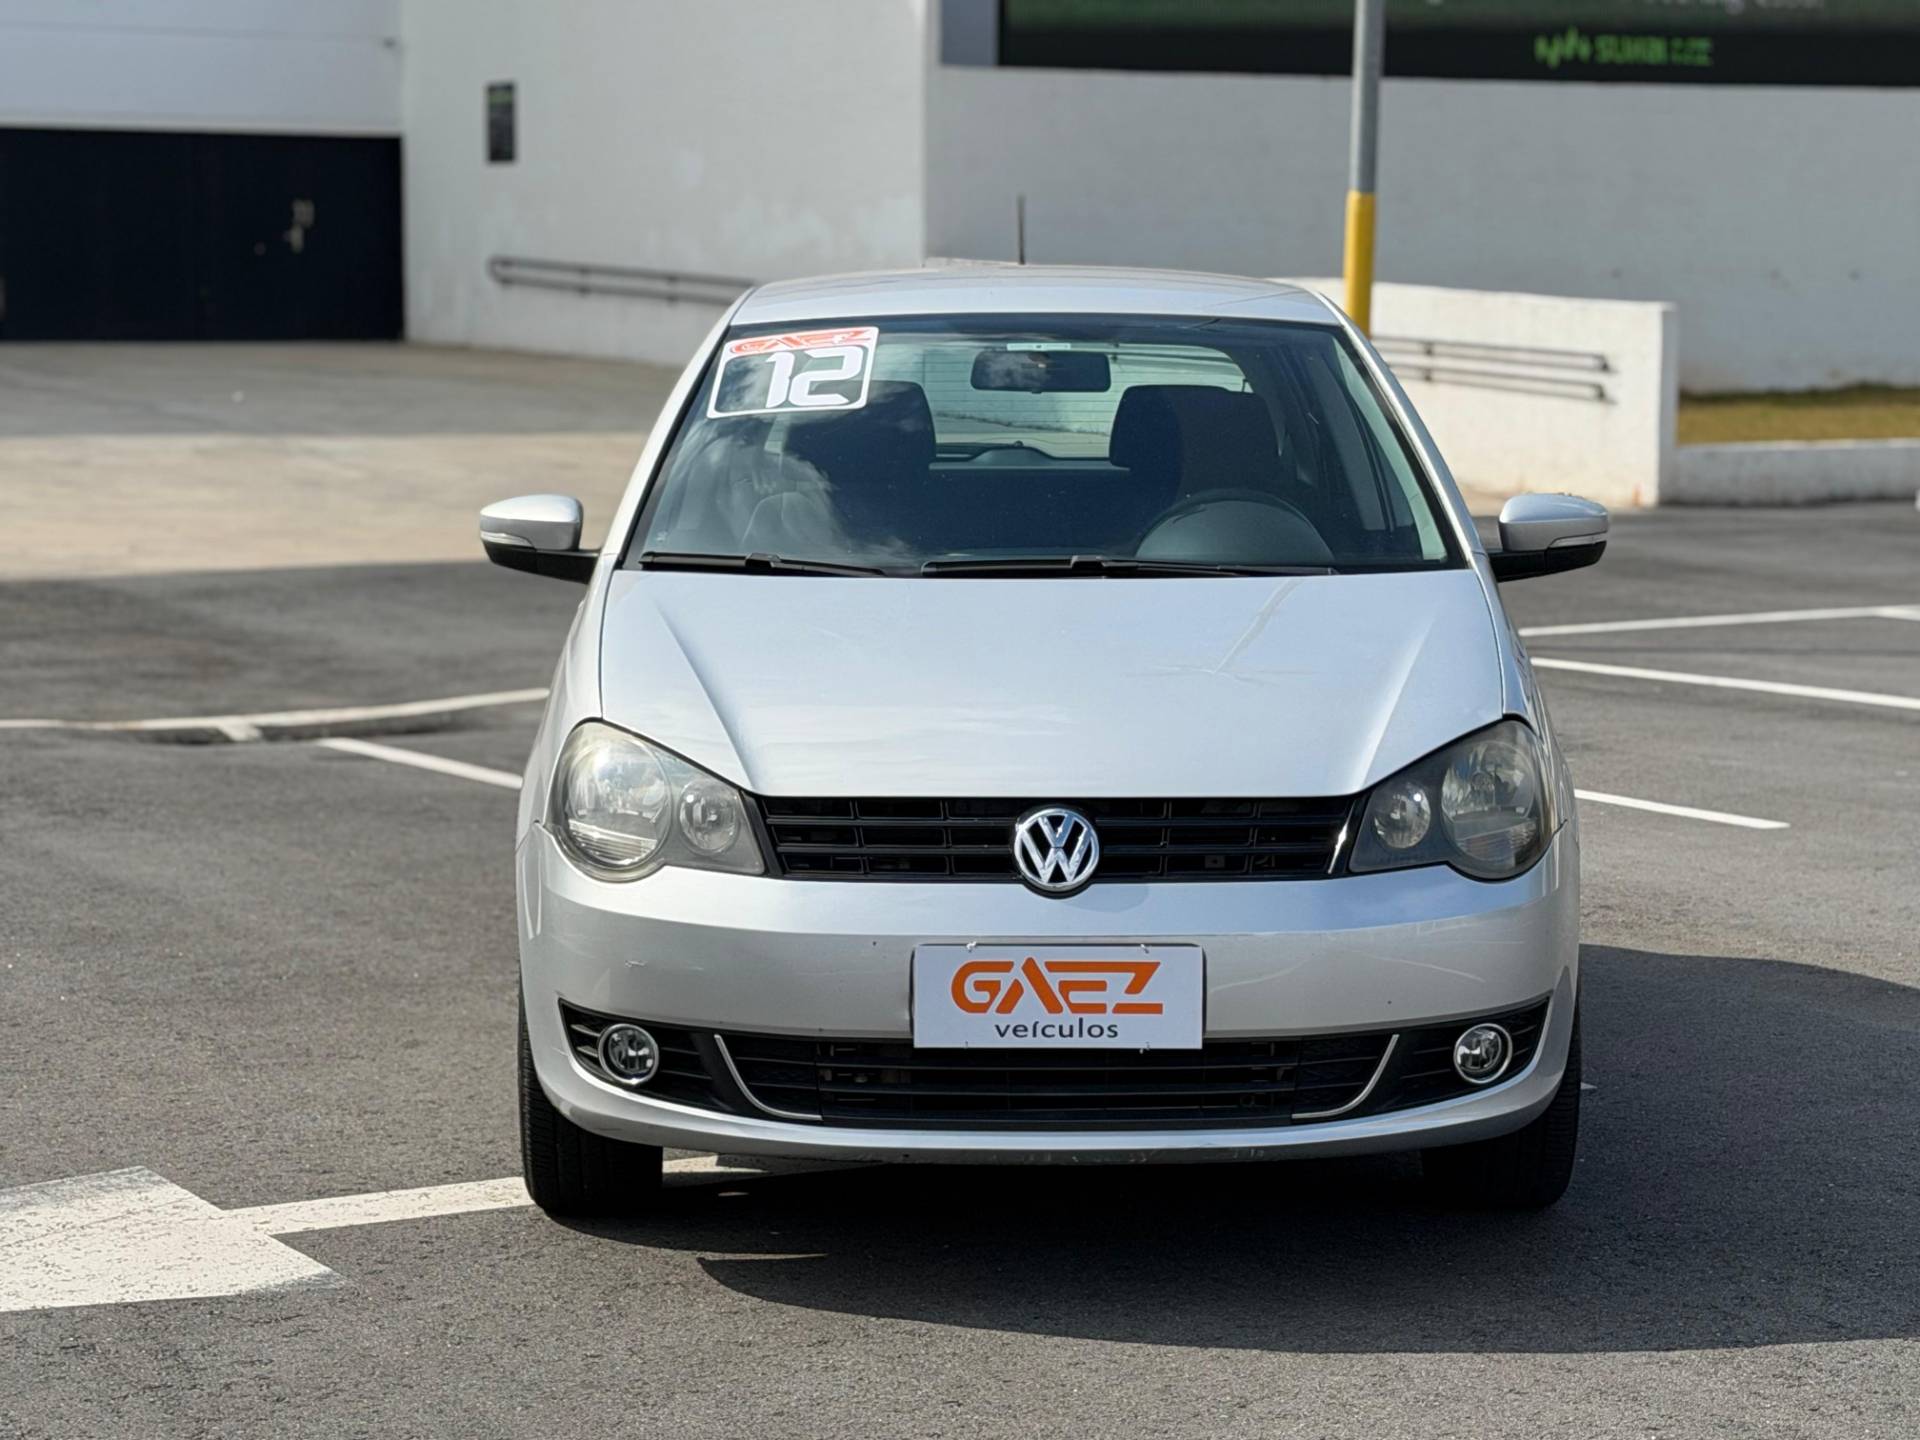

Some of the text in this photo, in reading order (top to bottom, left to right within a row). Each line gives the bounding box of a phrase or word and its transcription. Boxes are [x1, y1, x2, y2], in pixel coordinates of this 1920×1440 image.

[765, 346, 864, 409] 12
[1014, 808, 1099, 891] VW
[951, 957, 1164, 1015] GAEZ
[994, 1017, 1119, 1038] veículos
